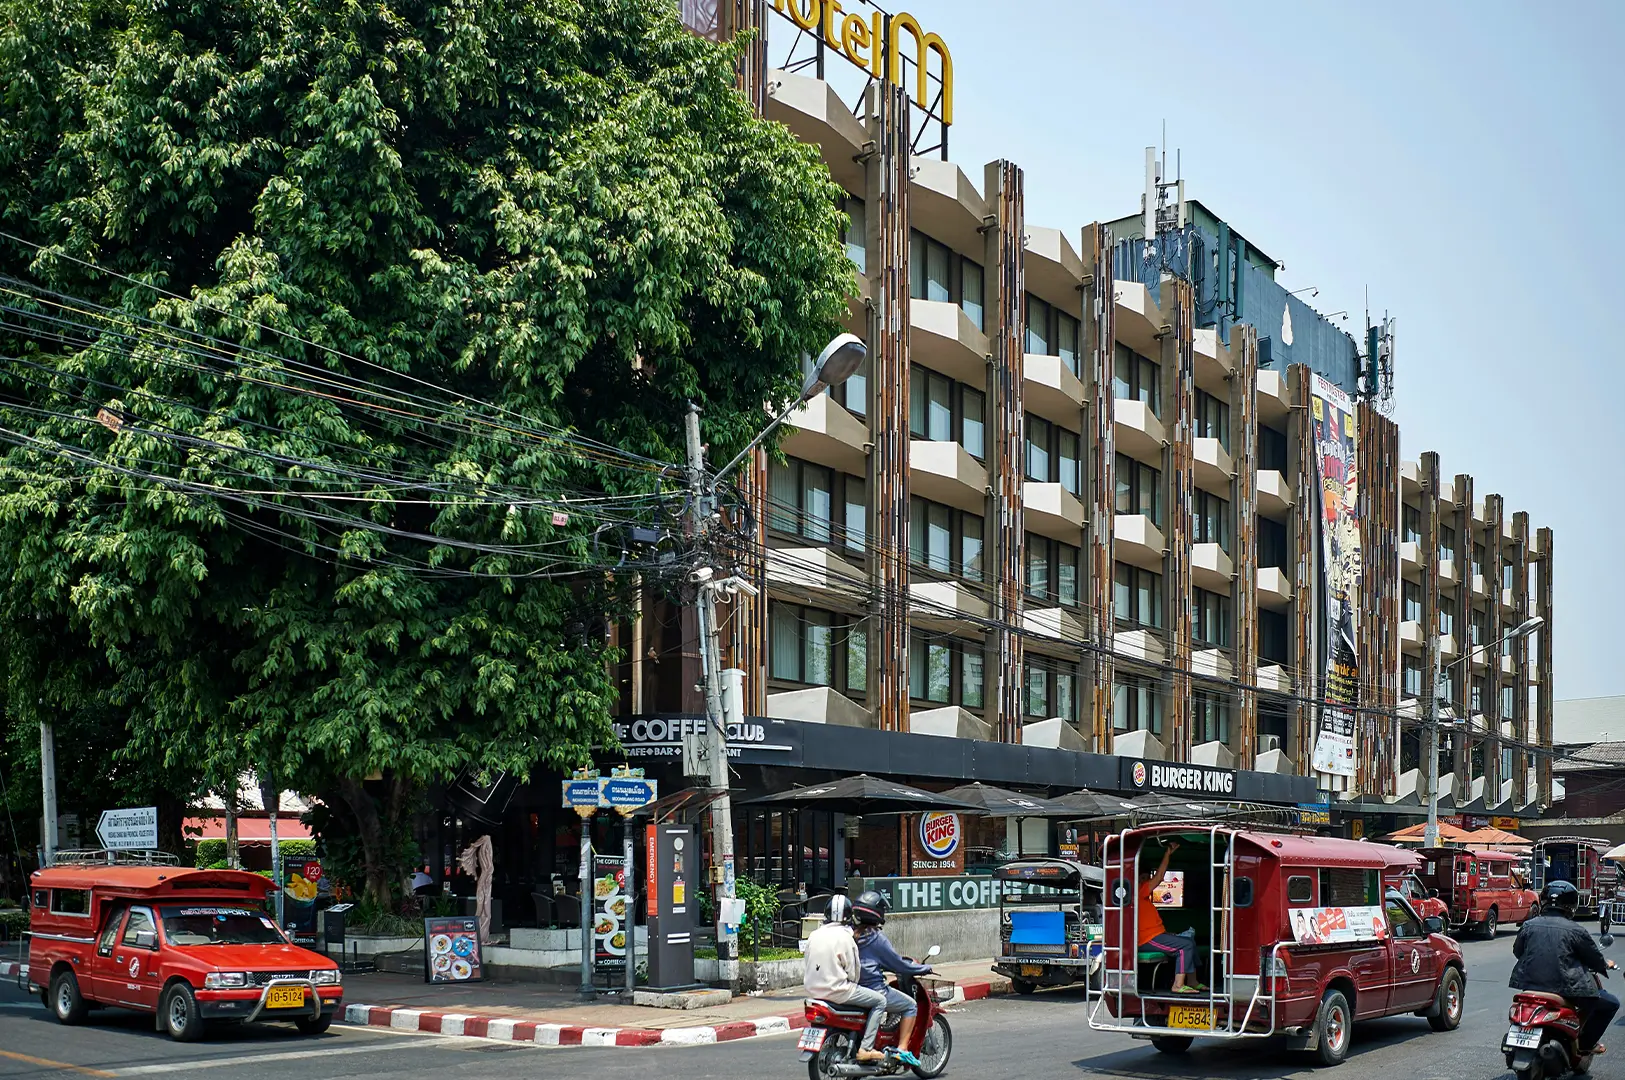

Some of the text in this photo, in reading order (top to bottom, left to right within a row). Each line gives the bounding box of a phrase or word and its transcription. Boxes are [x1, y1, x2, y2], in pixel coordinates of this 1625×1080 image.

[773, 0, 882, 78] otel
[726, 723, 765, 742] CLUB
[654, 747, 673, 756] BAR
[1151, 765, 1233, 793] BURGER KING
[926, 815, 953, 833] BURGER
[927, 824, 954, 845] KING
[306, 866, 320, 875] 120
[913, 861, 937, 869] SINCE
[898, 882, 941, 908] THE
